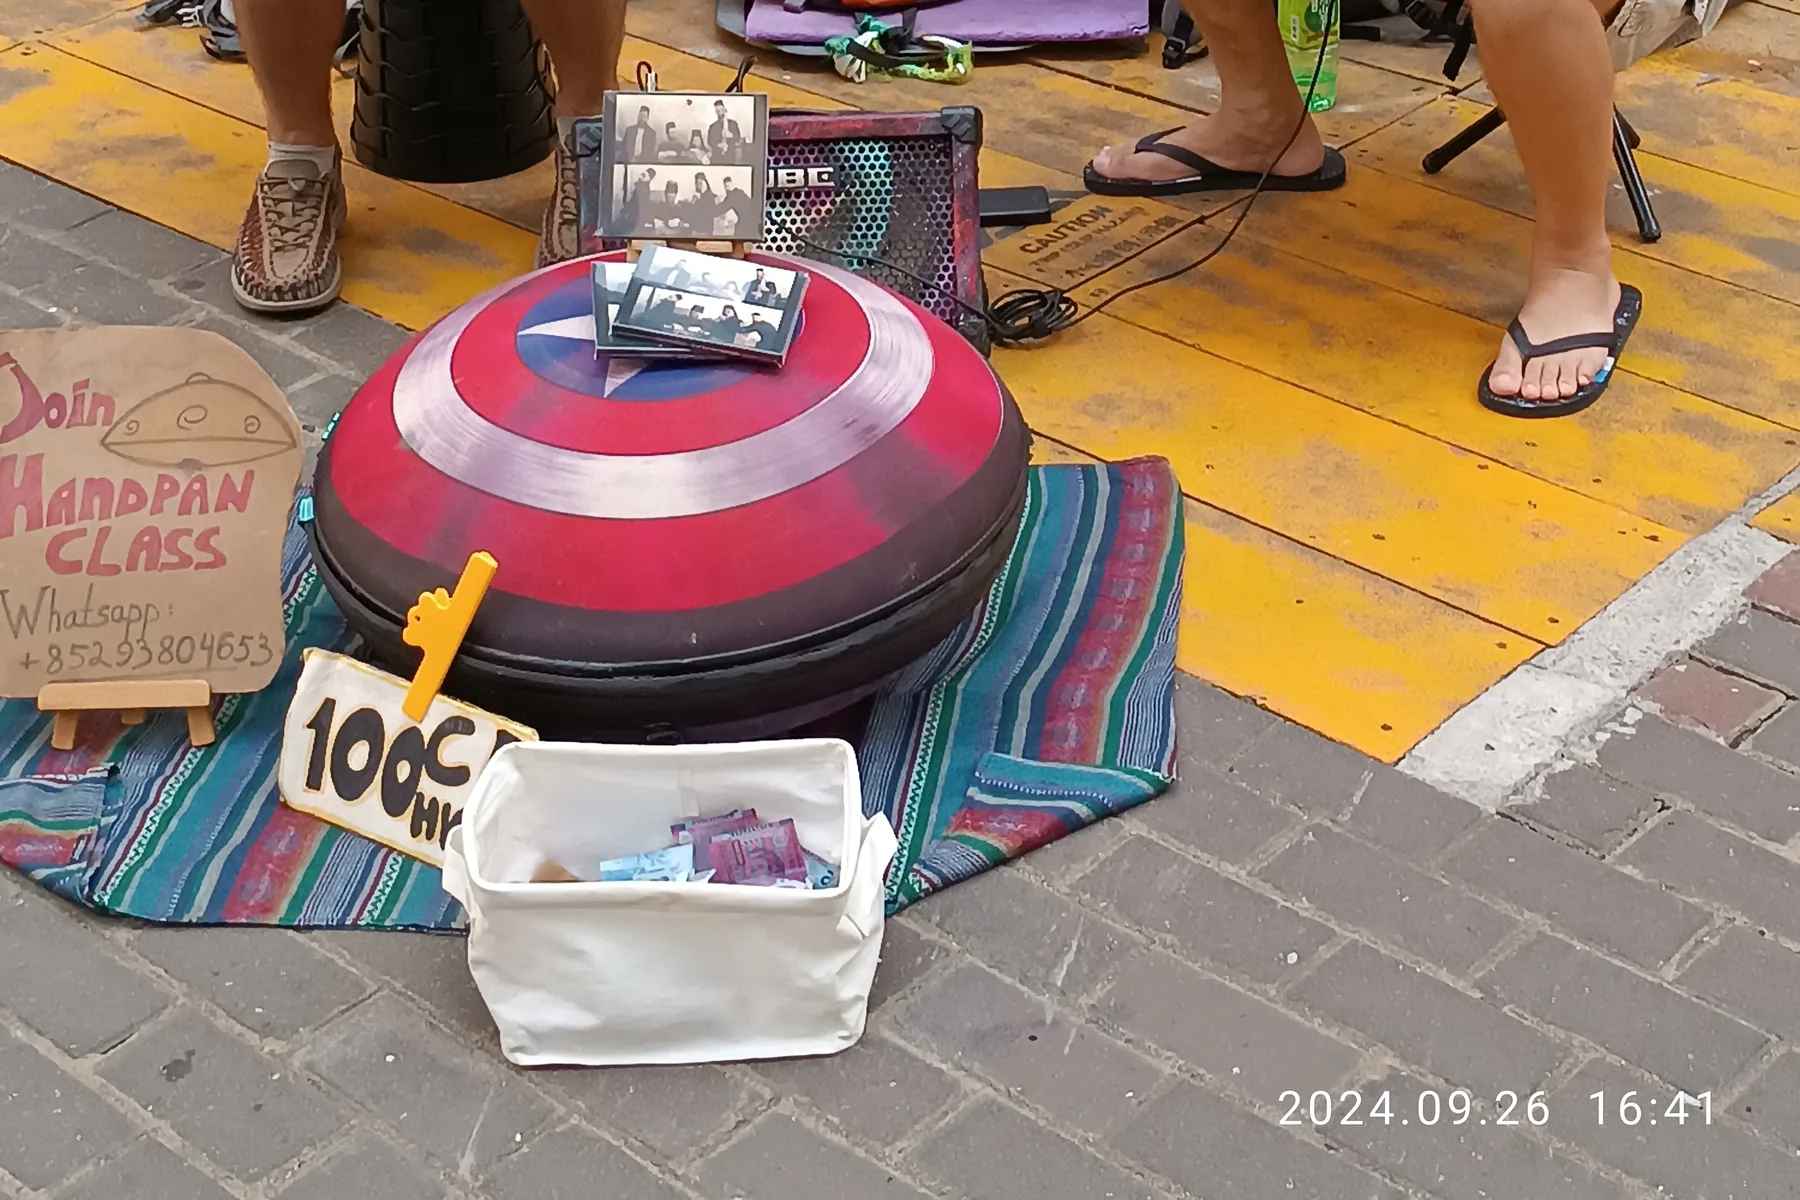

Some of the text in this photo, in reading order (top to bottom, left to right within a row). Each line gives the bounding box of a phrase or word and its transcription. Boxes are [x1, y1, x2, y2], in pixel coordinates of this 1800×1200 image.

[1019, 204, 1113, 255] CAUTION
[0, 352, 116, 444] Join
[45, 525, 227, 576] CLASS
